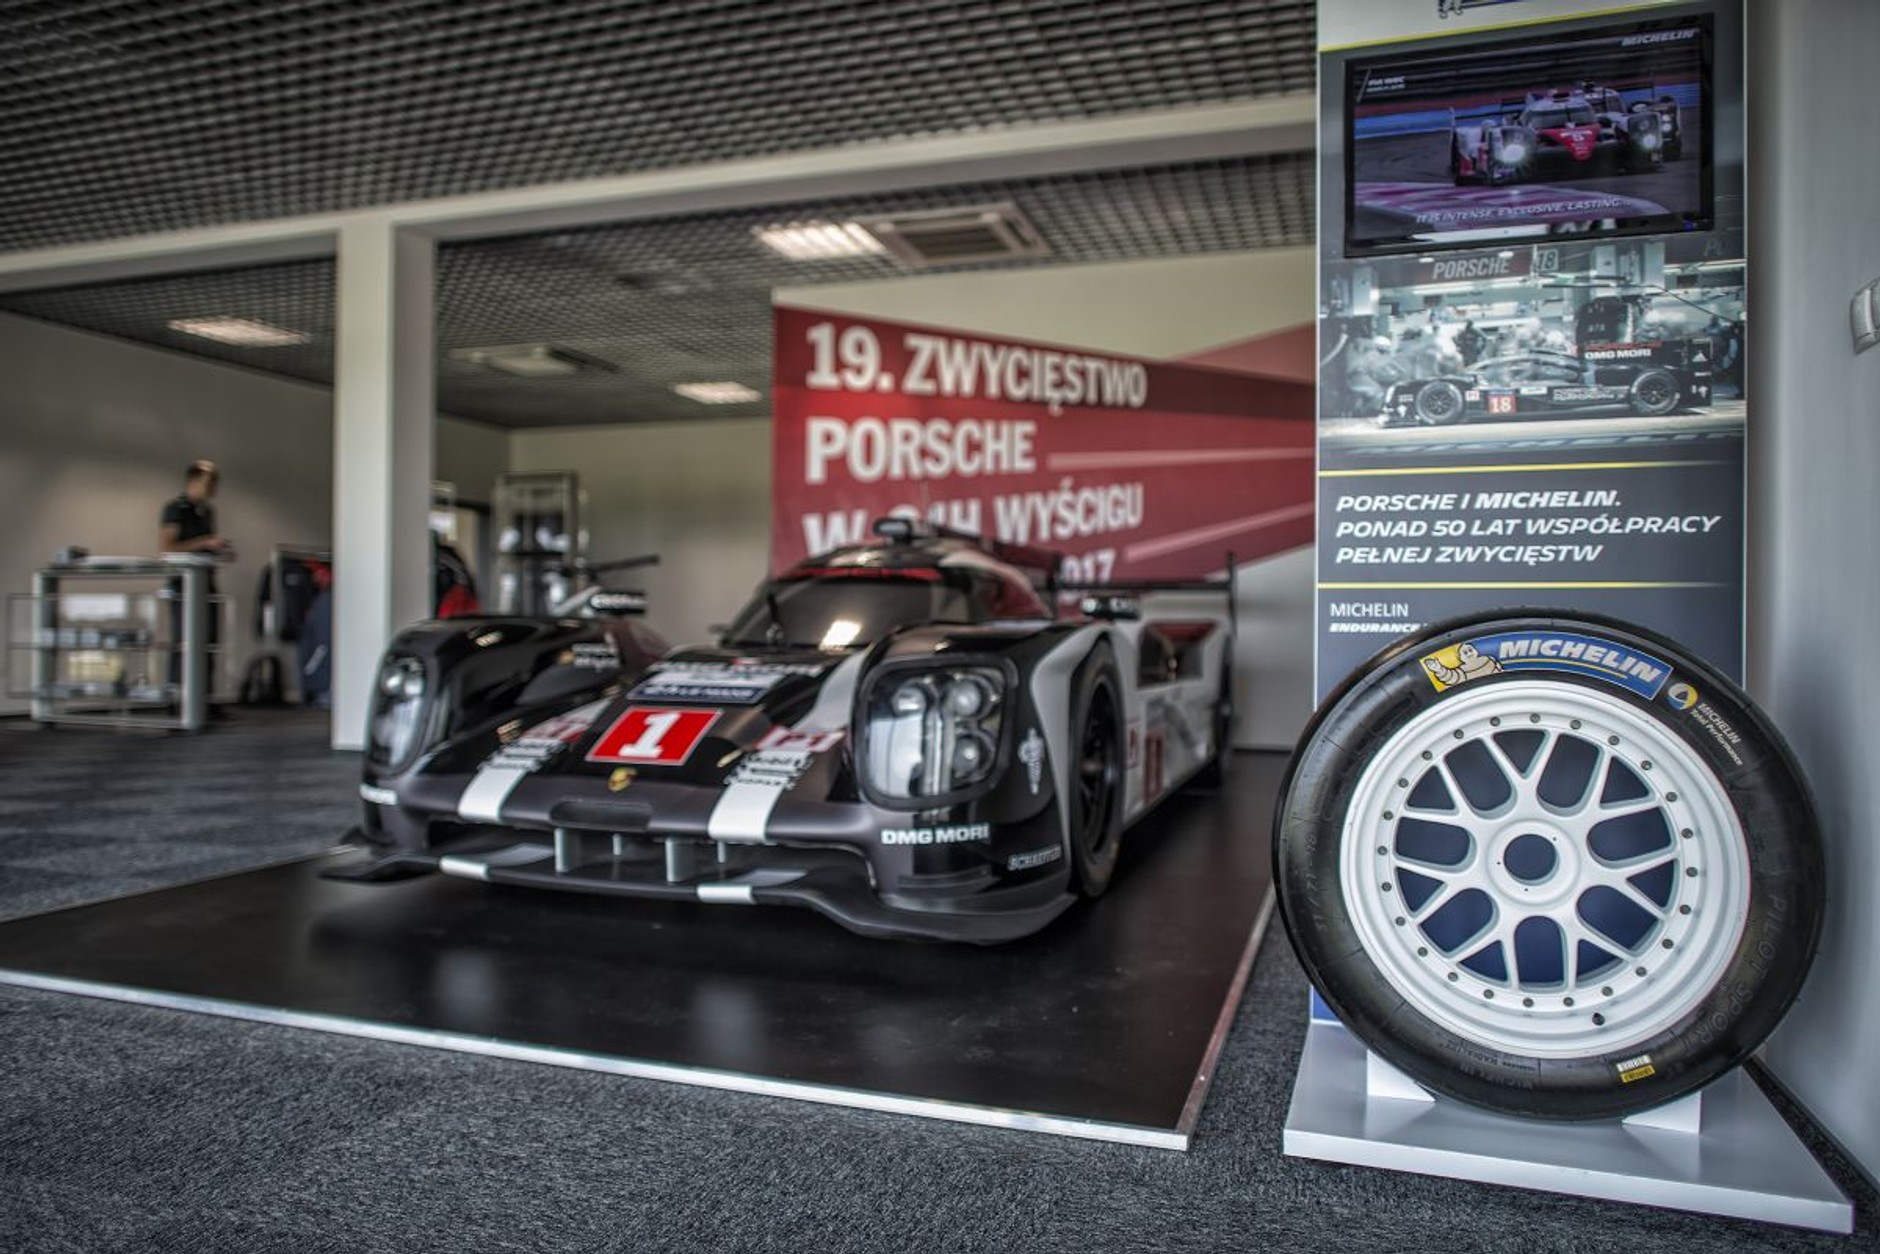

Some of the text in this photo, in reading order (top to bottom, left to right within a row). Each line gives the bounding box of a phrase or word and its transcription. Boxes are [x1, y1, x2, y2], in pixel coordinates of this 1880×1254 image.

[1432, 259, 1511, 279] PORSCHE
[805, 322, 1149, 416] 19. ZWYCIĘSTWO
[1491, 397, 1512, 413] 18
[804, 414, 1037, 485] PORSCHE
[1336, 490, 1621, 512] PORSCHE I MICHELIN.
[803, 511, 868, 558] W
[993, 475, 1145, 546] WYŚCIGU
[1336, 513, 1722, 538] PONAD 50 LAT WSPÓŁPRACY
[1336, 545, 1604, 566] PEŁNEJ ZWYCIĘSTW
[1329, 602, 1409, 617] MICHELIN
[1500, 639, 1663, 683] MICHELIN
[618, 711, 682, 759] 1
[1698, 703, 1742, 744] MICHELIN
[881, 822, 990, 845] DMG MORI
